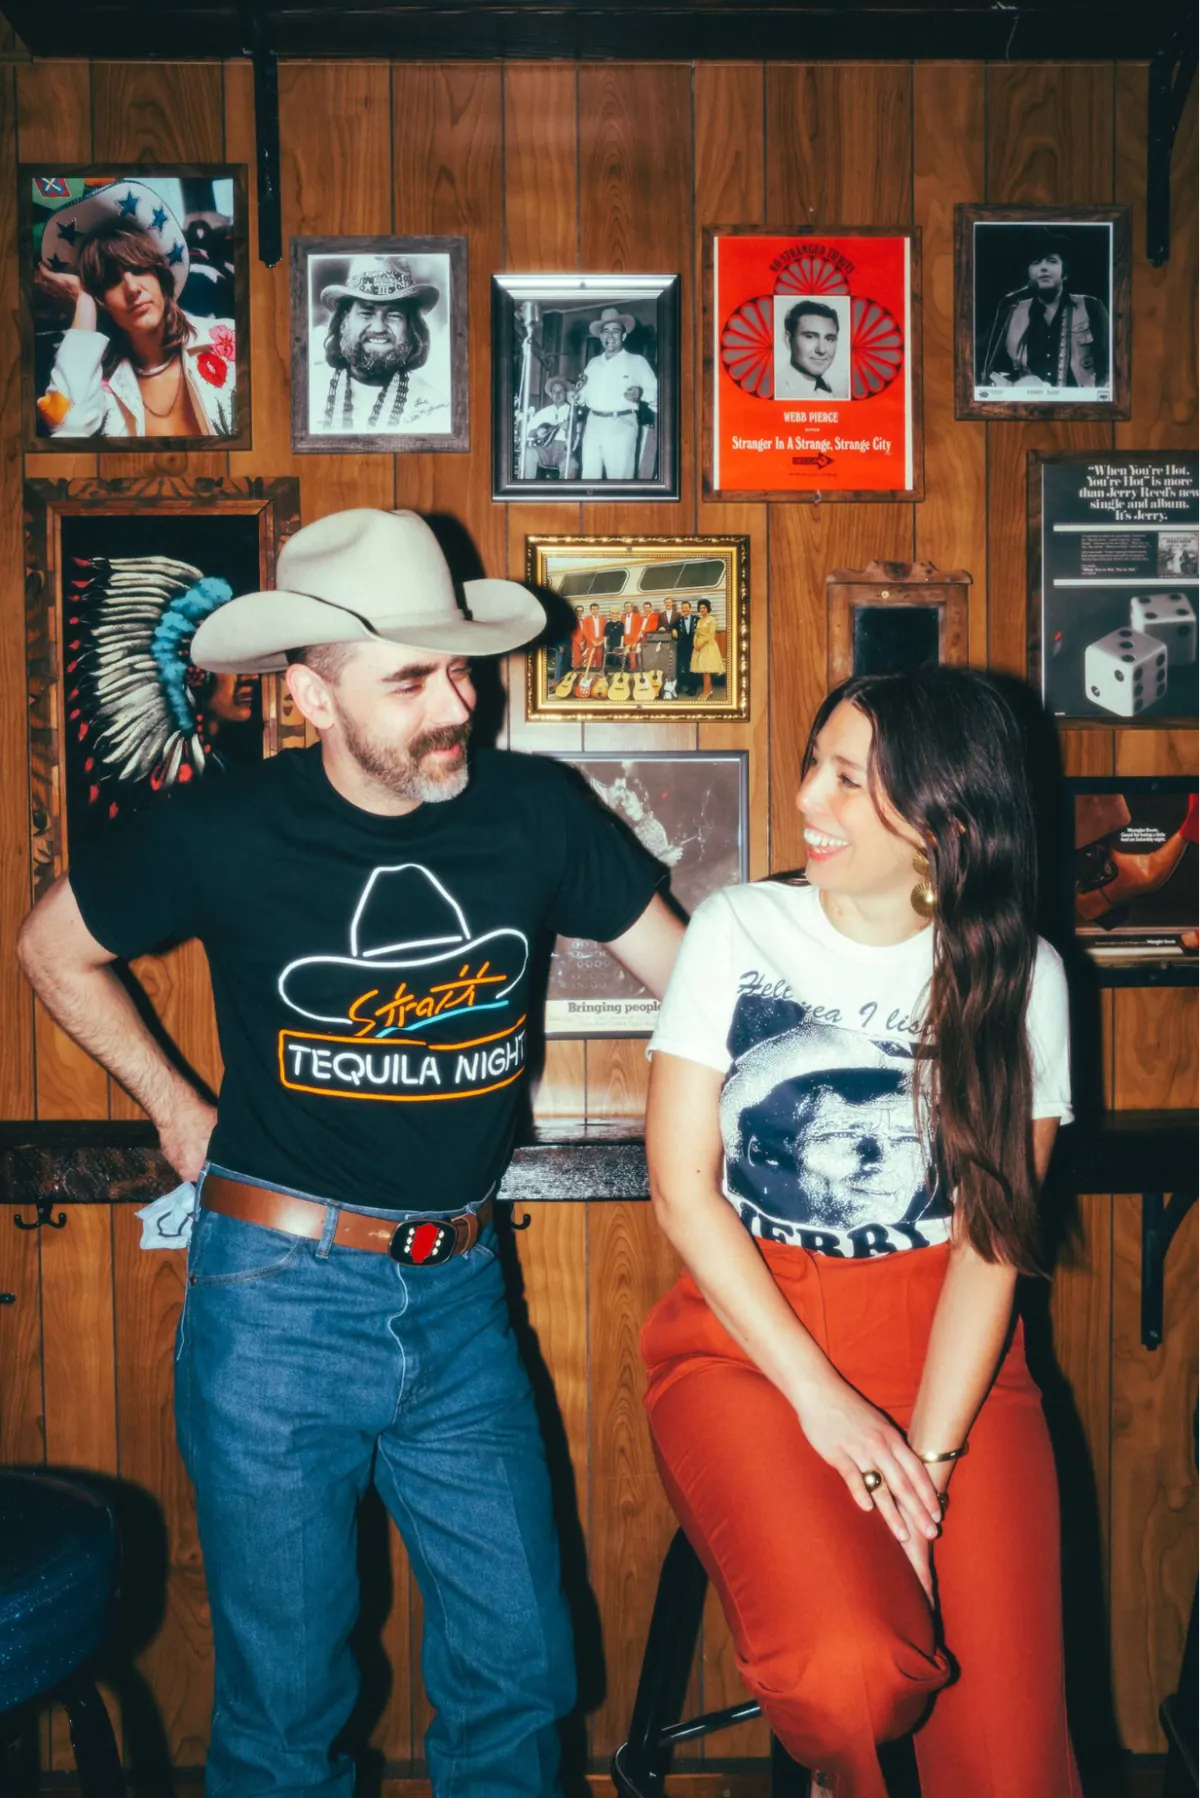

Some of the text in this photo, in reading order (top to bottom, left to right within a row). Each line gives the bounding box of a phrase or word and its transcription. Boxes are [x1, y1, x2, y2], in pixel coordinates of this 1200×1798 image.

[784, 411, 839, 423] WEBB PIERCE
[732, 436, 892, 453] Stranger In A Strange, Strange City
[1129, 464, 1163, 476] You're
[1086, 476, 1122, 487] You're
[1151, 476, 1162, 487] is
[1164, 478, 1193, 487] more
[1079, 487, 1200, 500] than Jerry Reed's new
[1090, 498, 1190, 511] single and album.
[1115, 510, 1168, 522] It's Jerry.
[568, 1002, 622, 1014] Bringing
[288, 1029, 526, 1086] TEQUILA NIGHT
